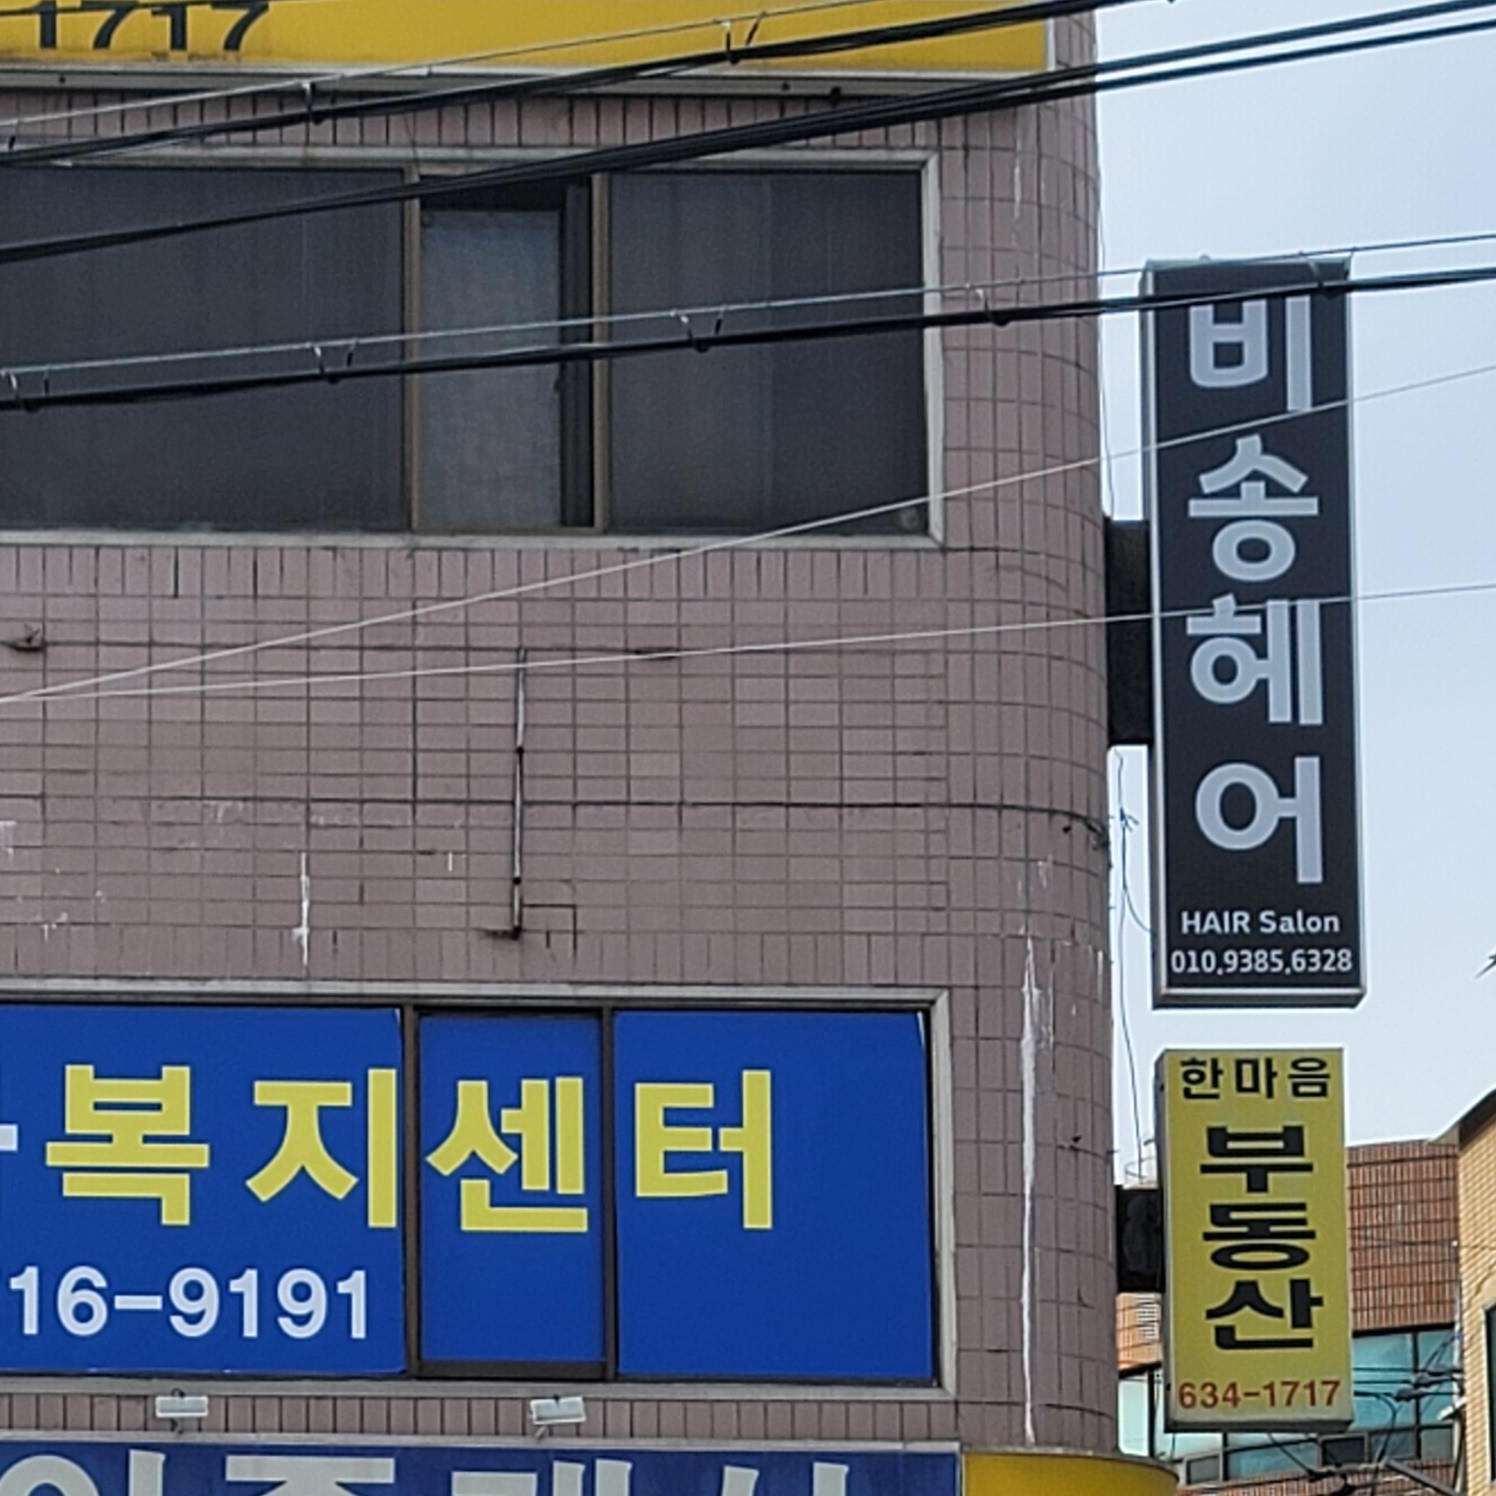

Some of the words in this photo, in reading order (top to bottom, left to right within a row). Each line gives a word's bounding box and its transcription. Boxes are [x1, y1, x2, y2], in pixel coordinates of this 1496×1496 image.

[1187, 294, 1324, 884] 비송헤어
[1181, 909, 1251, 934] HAIR
[1260, 908, 1341, 933] Salon
[1171, 949, 1353, 975] 010.9385.6328
[1180, 1057, 1331, 1100] 한마음
[1199, 1124, 1324, 1351] 부동산
[1178, 1379, 1341, 1409] 634-1717
